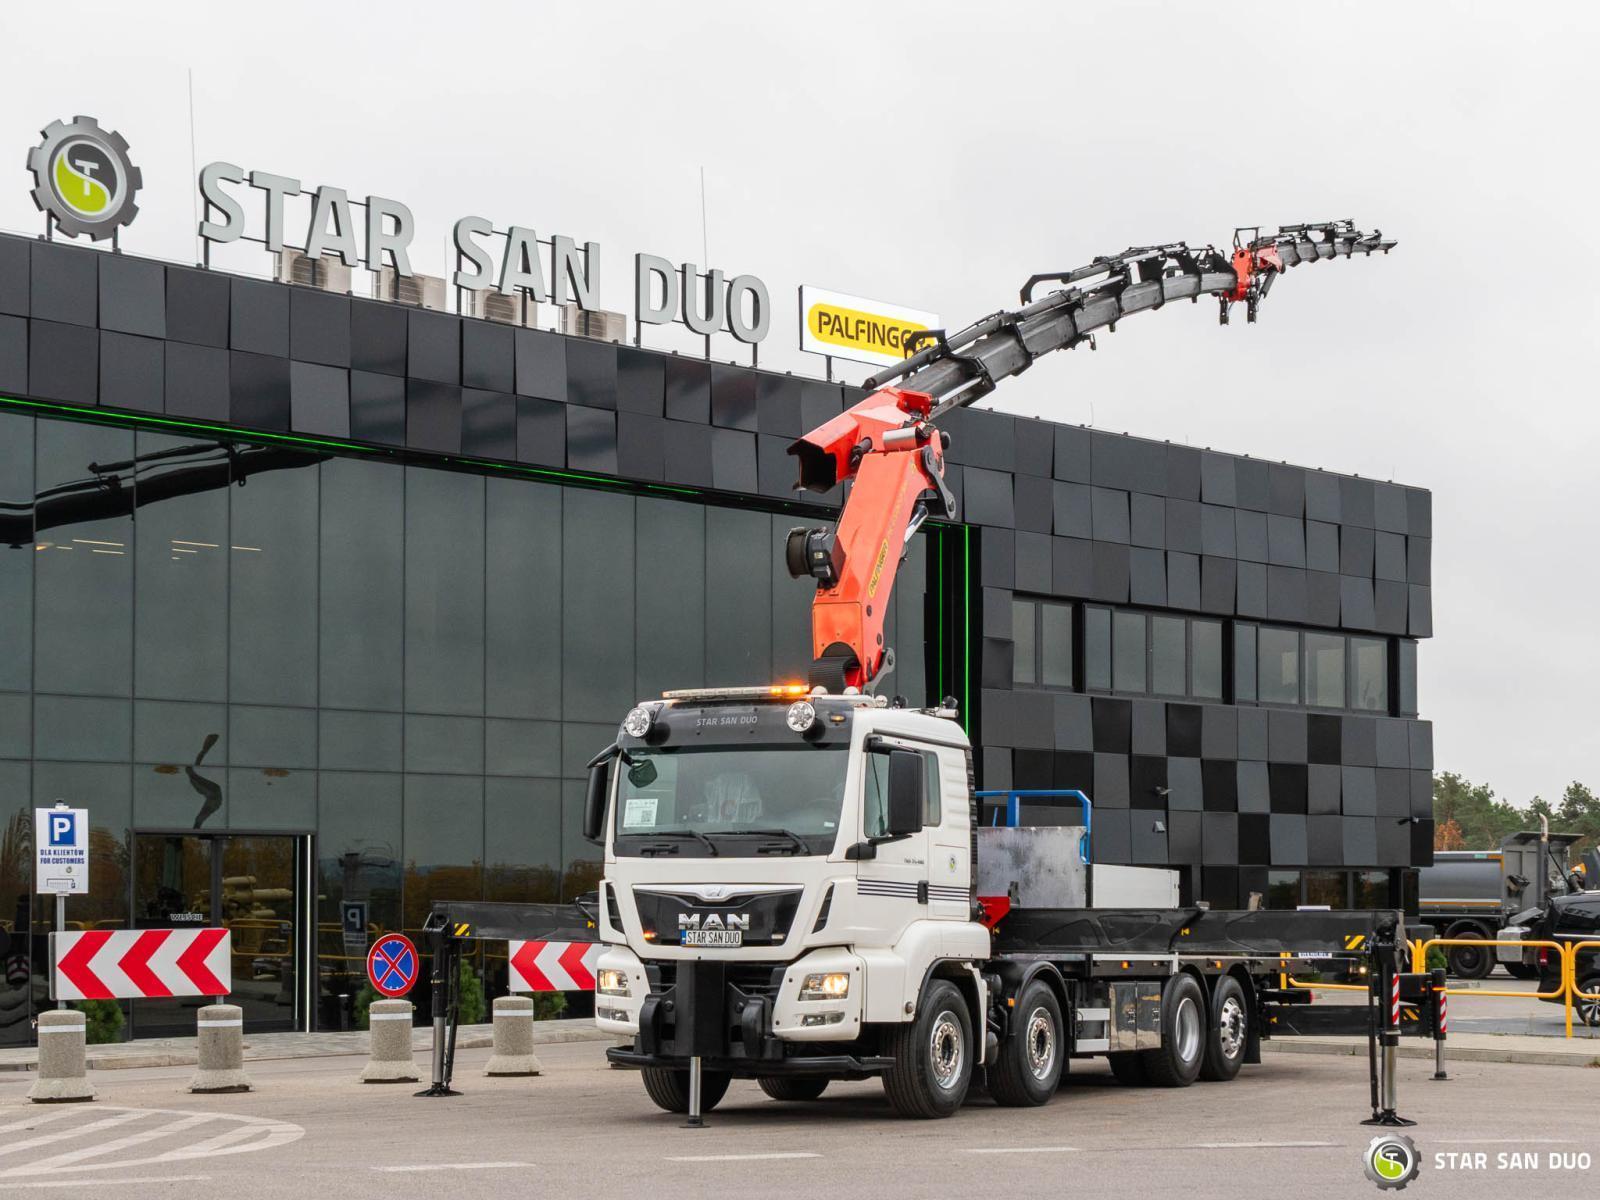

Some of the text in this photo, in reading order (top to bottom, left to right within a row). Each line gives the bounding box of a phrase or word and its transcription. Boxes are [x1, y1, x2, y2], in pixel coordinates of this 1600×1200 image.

[199, 161, 769, 343] STAR SAN DUO
[696, 715, 758, 726] STAR SAN DUO
[53, 817, 71, 841] P
[678, 913, 750, 930] MAN
[687, 931, 740, 944] STAR SAN DUO
